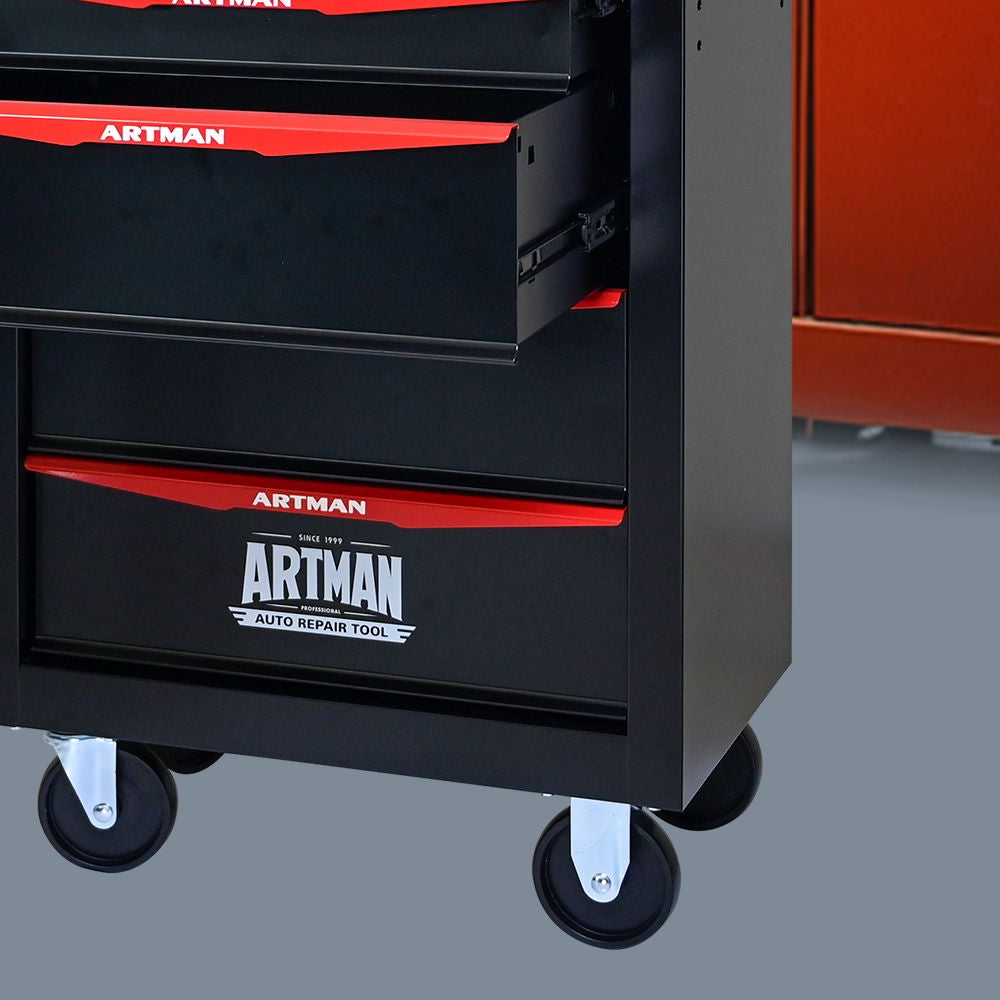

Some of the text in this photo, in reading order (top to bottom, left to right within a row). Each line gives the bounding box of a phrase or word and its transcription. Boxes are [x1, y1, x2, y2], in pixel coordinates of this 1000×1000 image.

[100, 125, 225, 145] ARTMAN
[252, 492, 366, 514] ARTMAN
[298, 533, 343, 545] SINCE 1999
[241, 541, 403, 622] ARTMAN
[301, 605, 341, 615] PROFESSIONAL
[255, 613, 388, 638] AUTO REPAIR TOOL
